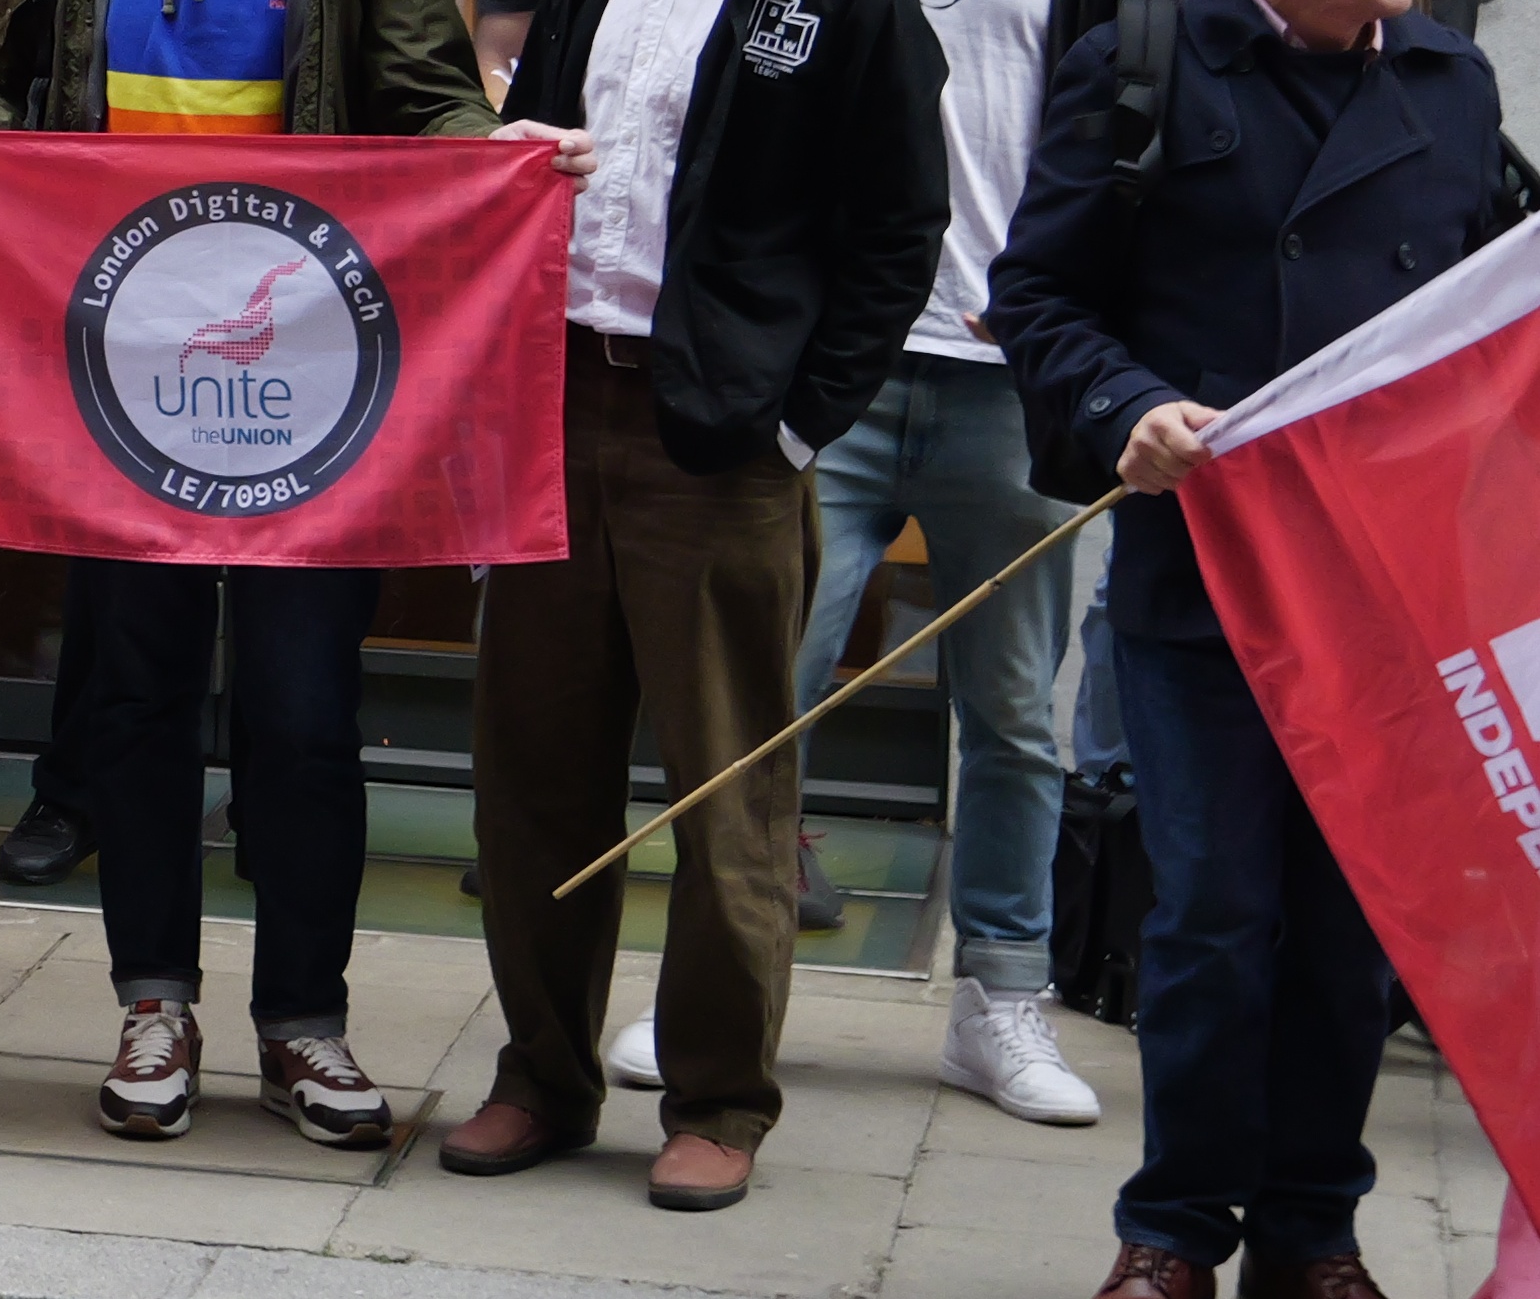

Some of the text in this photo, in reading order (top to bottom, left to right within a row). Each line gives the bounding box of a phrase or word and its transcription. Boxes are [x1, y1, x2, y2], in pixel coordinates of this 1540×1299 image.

[83, 188, 384, 323] London Digital & Tech
[161, 468, 311, 511] LE/7098L
